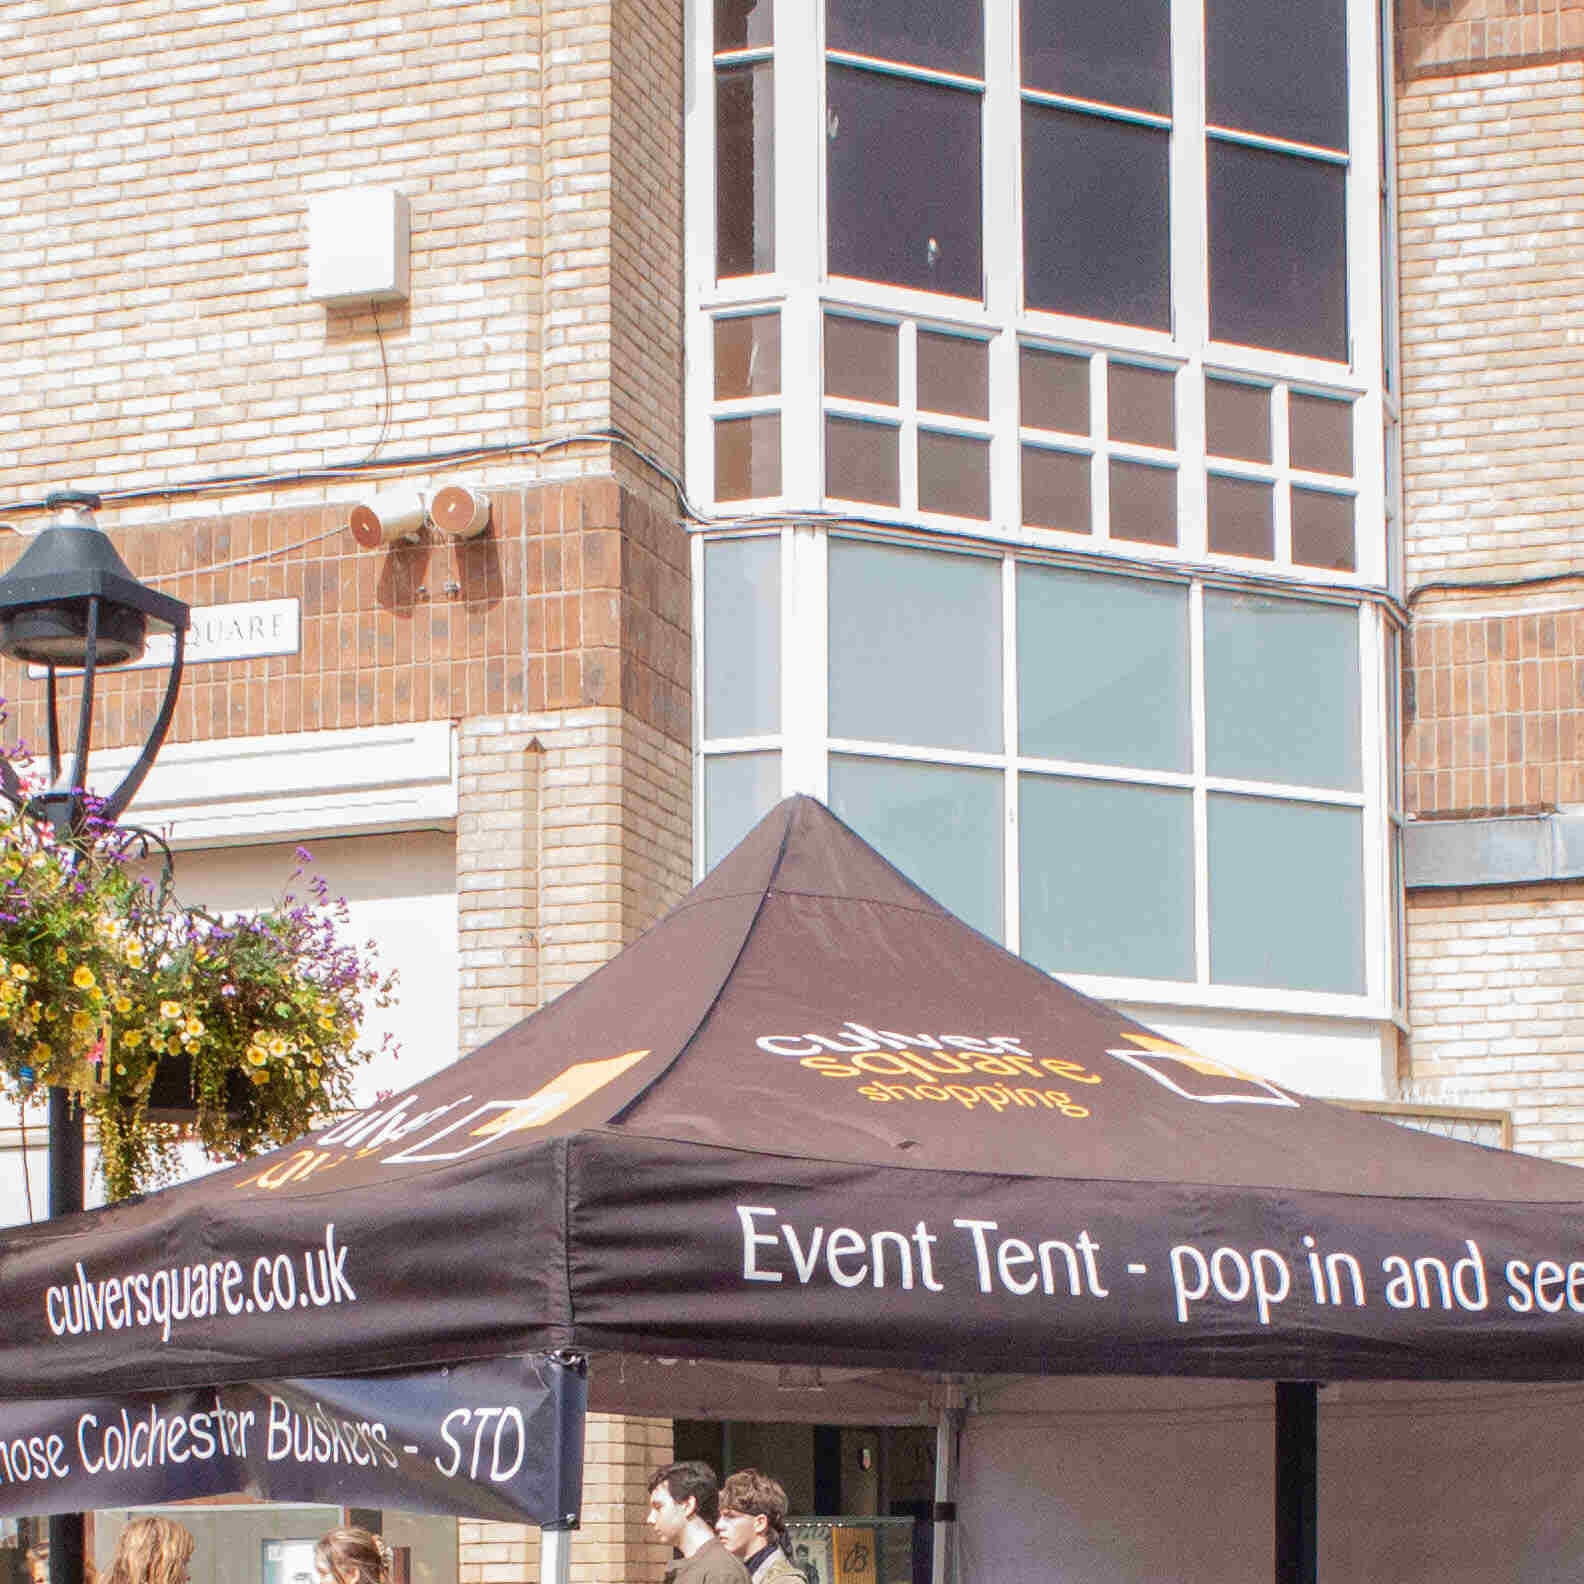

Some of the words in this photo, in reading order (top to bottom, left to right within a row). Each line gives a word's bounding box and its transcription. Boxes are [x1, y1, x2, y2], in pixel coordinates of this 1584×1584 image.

[755, 1021, 1033, 1057] culver
[799, 1050, 1103, 1085] square
[856, 1081, 1090, 1119] shopping
[46, 1222, 357, 1342] culversquare.co.uk
[736, 1205, 945, 1292] Event
[952, 1218, 1110, 1299] Tent
[1126, 1263, 1147, 1275] -
[1169, 1244, 1291, 1326] pop
[1302, 1234, 1367, 1308] in
[1382, 1239, 1490, 1312] and
[77, 1395, 256, 1475] Colchester
[266, 1394, 400, 1470] Buskers
[434, 1406, 526, 1483] STD
